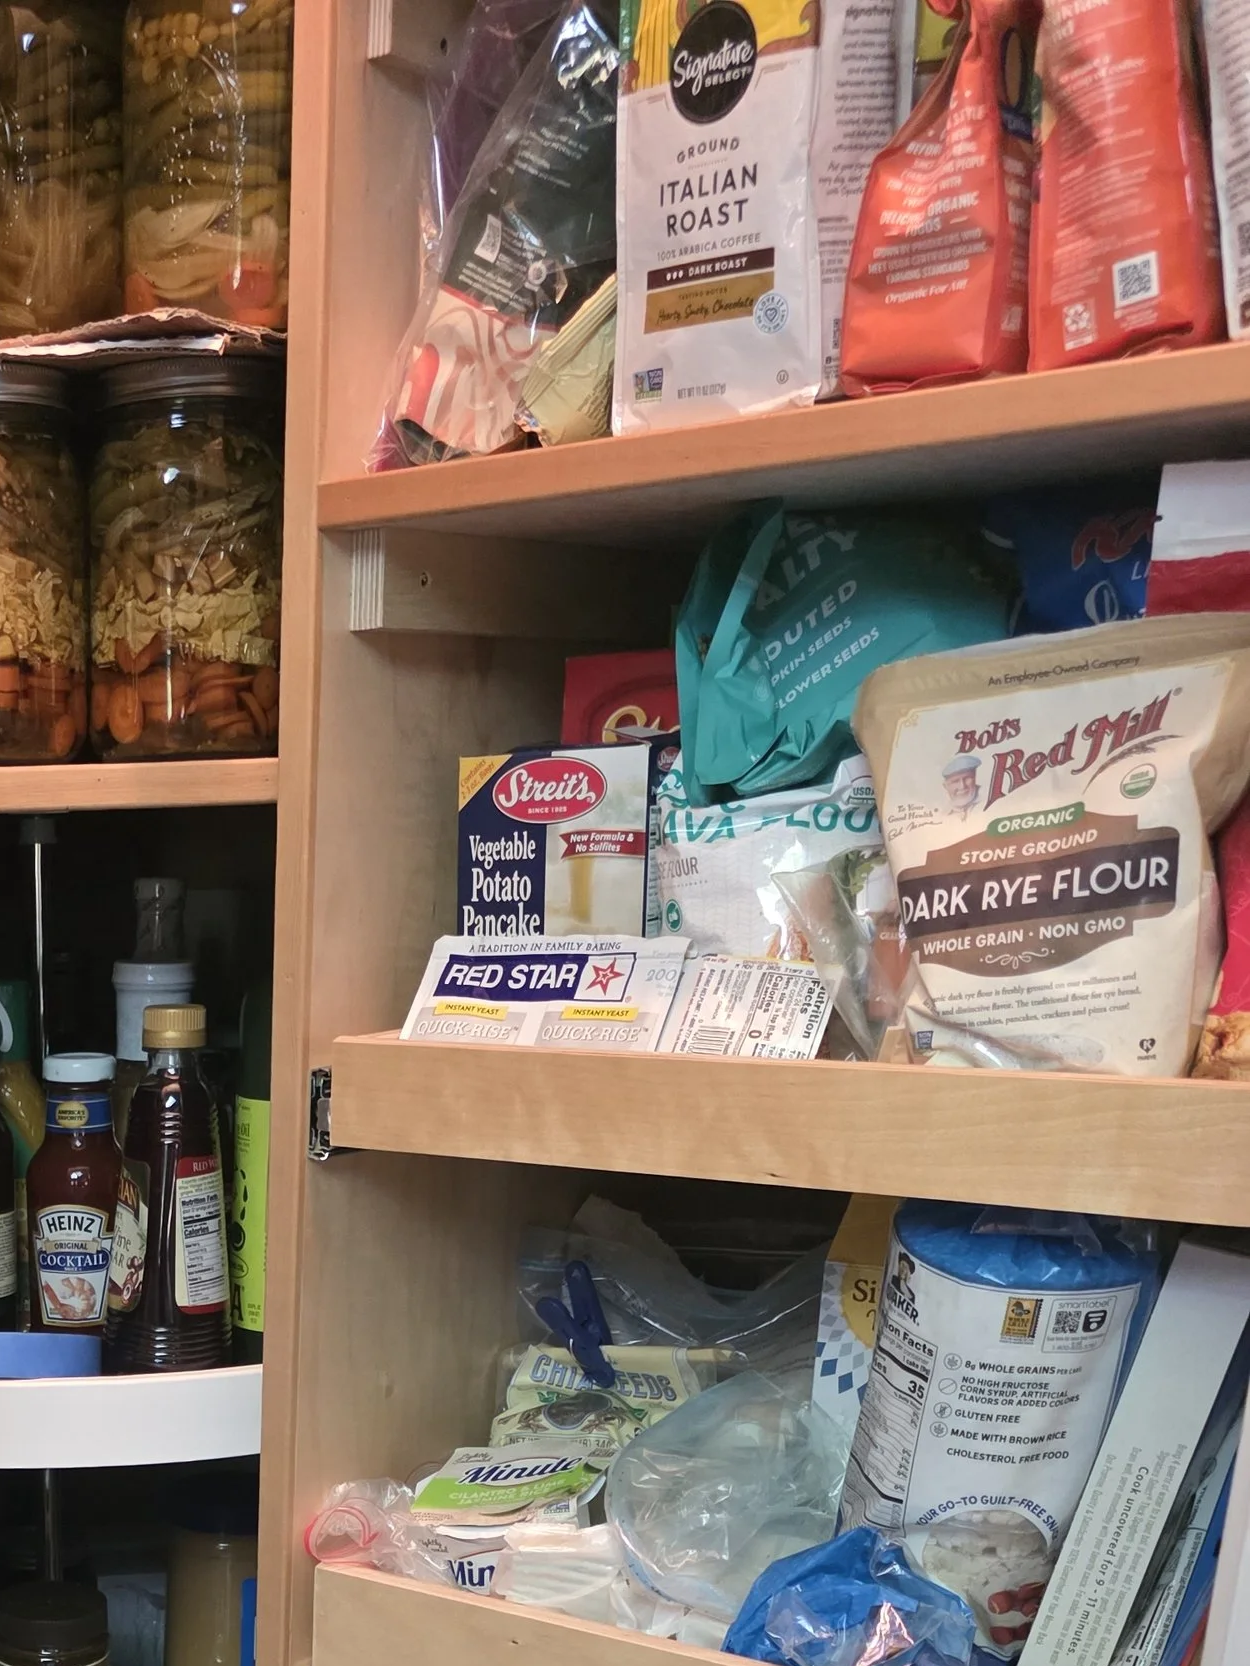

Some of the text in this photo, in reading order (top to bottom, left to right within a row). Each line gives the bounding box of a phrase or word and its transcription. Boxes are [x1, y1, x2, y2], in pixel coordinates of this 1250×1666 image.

[673, 39, 754, 95] Signature
[676, 136, 740, 165] GROUND
[660, 162, 758, 208] ITALIAN
[927, 190, 981, 217] ORGANIC
[667, 198, 749, 238] ROAST
[678, 241, 717, 259] ARABICA
[720, 232, 762, 249] COFFEE
[688, 256, 748, 277] DARK ROAST
[808, 616, 853, 656] SEEDS
[988, 655, 1140, 687] An Employee-Owned Company
[955, 717, 1021, 754] Bob's
[983, 689, 1174, 812] Red Mill
[498, 768, 596, 808] Streit's
[997, 807, 1075, 834] ORGANIC
[469, 831, 536, 869] Vegetable
[570, 832, 634, 843] New Formula &
[575, 842, 621, 853] No Sulfites
[960, 829, 1098, 865] STONE GROUND
[471, 867, 532, 903] Potato
[901, 856, 1169, 928] DARK RYE FLOUR
[462, 905, 541, 937] Pancake
[530, 943, 541, 952] IN
[545, 942, 583, 952] FAMILY
[586, 942, 622, 952] BAKING
[923, 916, 1126, 956] WHOLE GRAIN NON GMO
[445, 963, 579, 989] RED STAR
[445, 1003, 500, 1016] INSTANT YEAST
[800, 979, 821, 1014] Facts
[573, 1009, 630, 1017] INSTANT YEAST
[417, 1020, 512, 1041] QUICK-RISE
[541, 1024, 641, 1042] QUICK-RISE
[46, 1215, 96, 1234] HEINZ
[39, 1252, 107, 1267] COCKTAIL
[54, 1241, 88, 1251] ORIGINAL
[902, 1331, 934, 1358] Facts
[530, 1354, 678, 1401] CHIA EEDS
[965, 1360, 977, 1371] 8g
[979, 1361, 1015, 1374] WHOLE
[1017, 1365, 1056, 1375] GRAINS
[907, 1379, 926, 1400] 35
[960, 1384, 985, 1396] CORN
[1021, 1390, 1069, 1400] ARTIFICIAL
[962, 1376, 1050, 1390] NO HIGH FRUCTOSE
[958, 1393, 1080, 1408] FLAVORS OR ADDED COLORS
[955, 1409, 1021, 1424] GLUTEN FREE
[950, 1428, 1067, 1445] MADE WITH BROWN RICE
[946, 1447, 1069, 1464] CHOLESTEROL FREE FOOD
[458, 1457, 583, 1485] Minute
[938, 1495, 978, 1513] GO-TO
[980, 1495, 1046, 1519] GUILT-FREE
[1065, 1466, 1150, 1656] Cook uncovered for 9 11 minutes.
